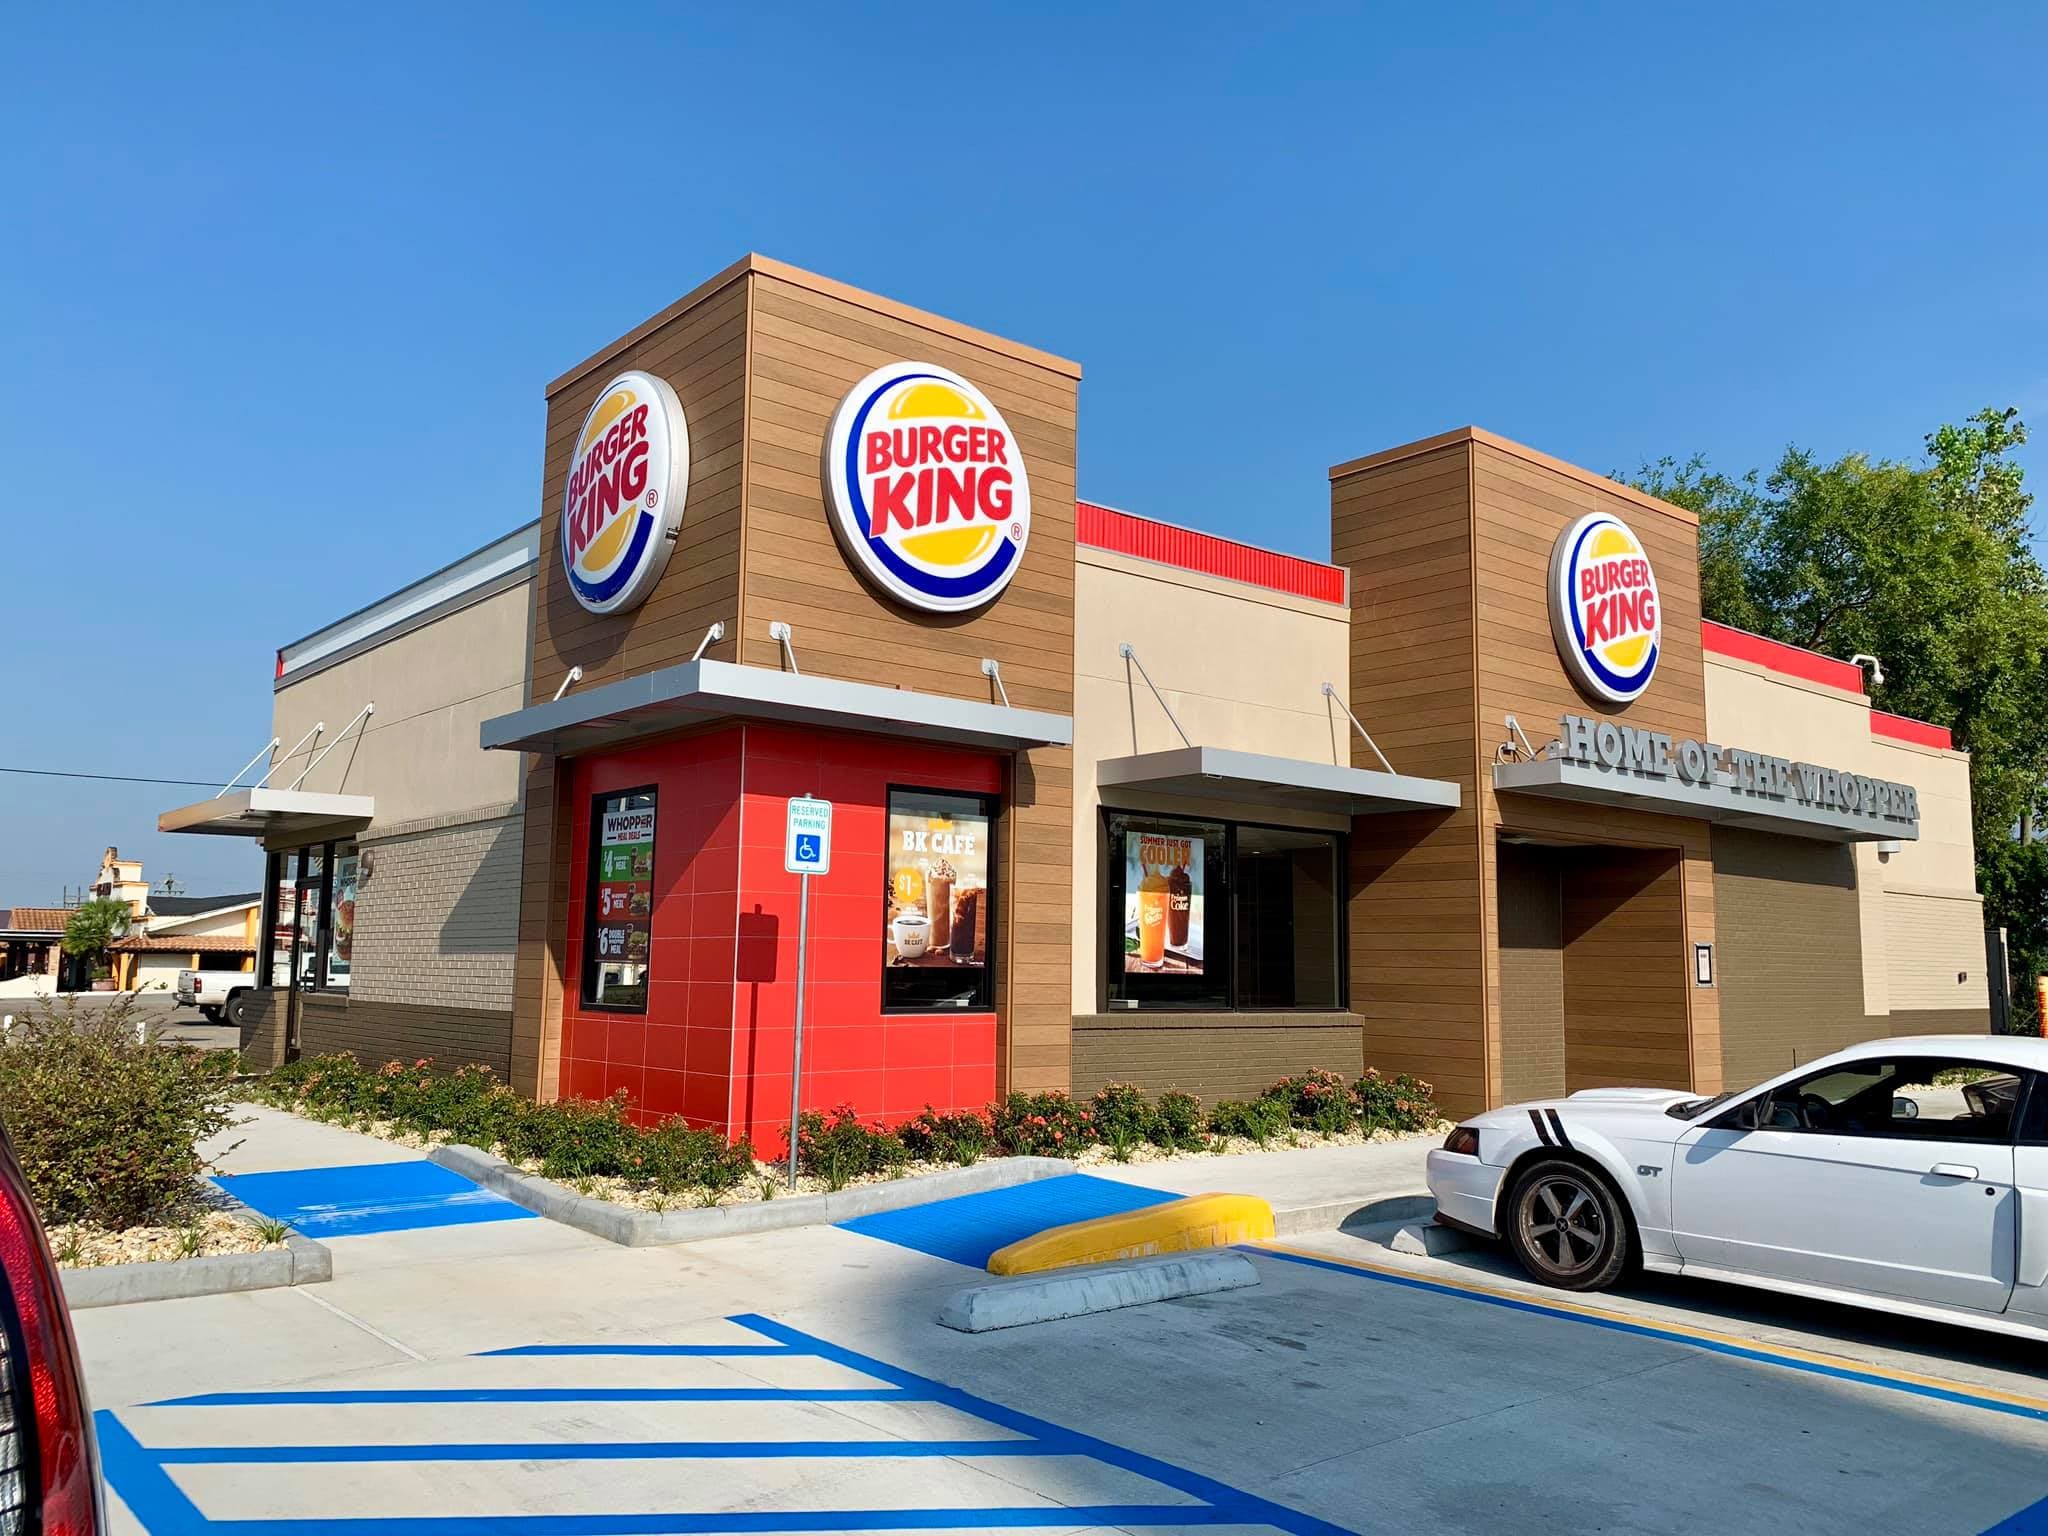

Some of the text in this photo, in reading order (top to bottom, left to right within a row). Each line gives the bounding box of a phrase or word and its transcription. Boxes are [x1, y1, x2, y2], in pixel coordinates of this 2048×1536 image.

[568, 403, 649, 520] BURGER
[866, 425, 1008, 475] BURGER
[568, 440, 649, 569] KING
[868, 467, 1014, 538] KING
[1580, 559, 1651, 602] BURGER
[1585, 588, 1656, 650] KING
[1560, 713, 1921, 821] HOME OF THE WHOPPER
[607, 814, 653, 832] WHOPPER
[791, 805, 829, 817] RESERVED
[793, 817, 826, 829] PARKING
[902, 830, 976, 856] BK CAFÉ
[1138, 845, 1192, 865] COOLER
[1140, 836, 1192, 849] SUMMER JUST GOT
[1170, 900, 1189, 911] Coke
[1637, 1165, 1663, 1177] GT
